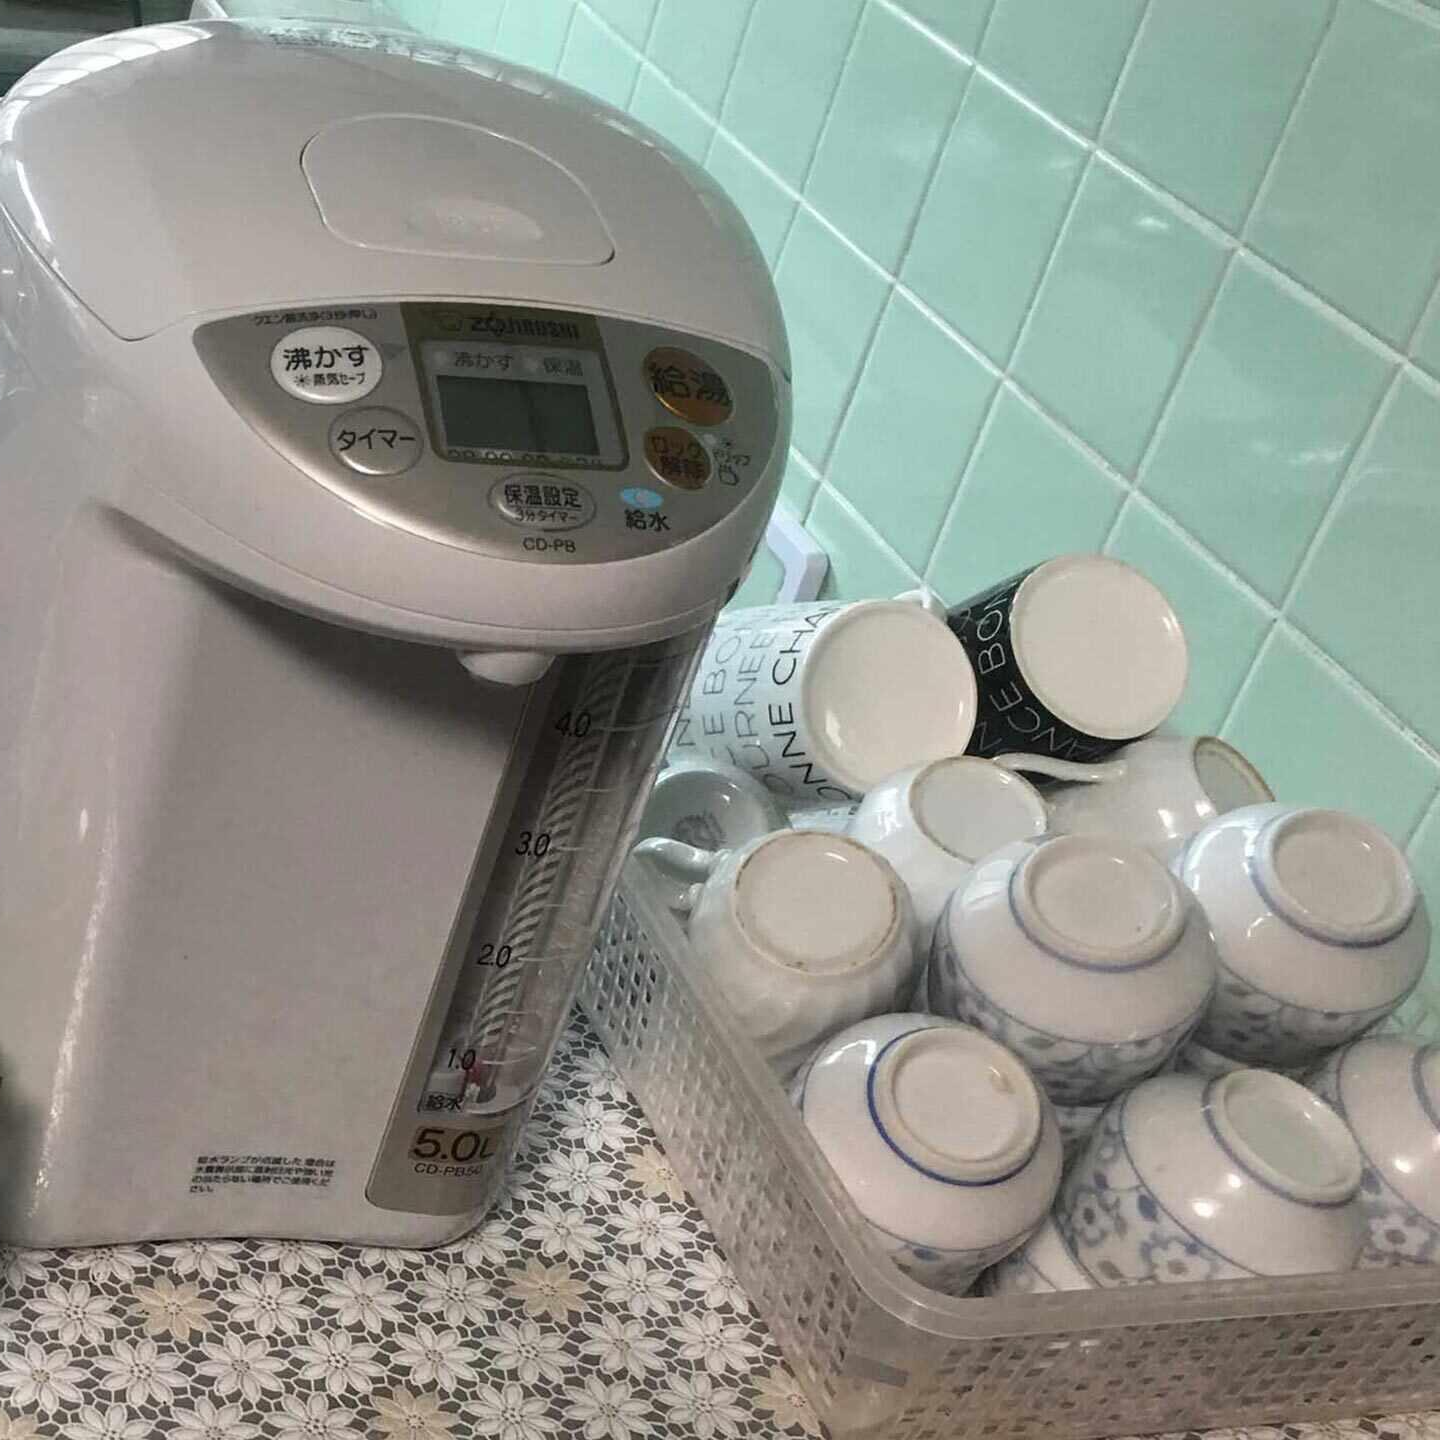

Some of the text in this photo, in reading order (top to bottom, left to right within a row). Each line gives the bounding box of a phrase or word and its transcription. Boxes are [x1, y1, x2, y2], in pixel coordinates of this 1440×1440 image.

[471, 311, 580, 340] ZOJIRUSHI
[282, 345, 369, 371] 沸かす
[454, 351, 514, 369] 沸かす
[543, 356, 584, 377] 保温
[648, 362, 731, 407] 給湯
[337, 428, 416, 451] タイマー
[651, 435, 702, 458] ロック
[504, 484, 582, 508] 保温設定
[625, 509, 670, 531] 給水
[523, 537, 576, 553] CD-PB
[555, 711, 591, 740] 4.0
[515, 832, 551, 859] 3.0
[477, 943, 513, 968] 2.0
[447, 1048, 477, 1071] 1.0
